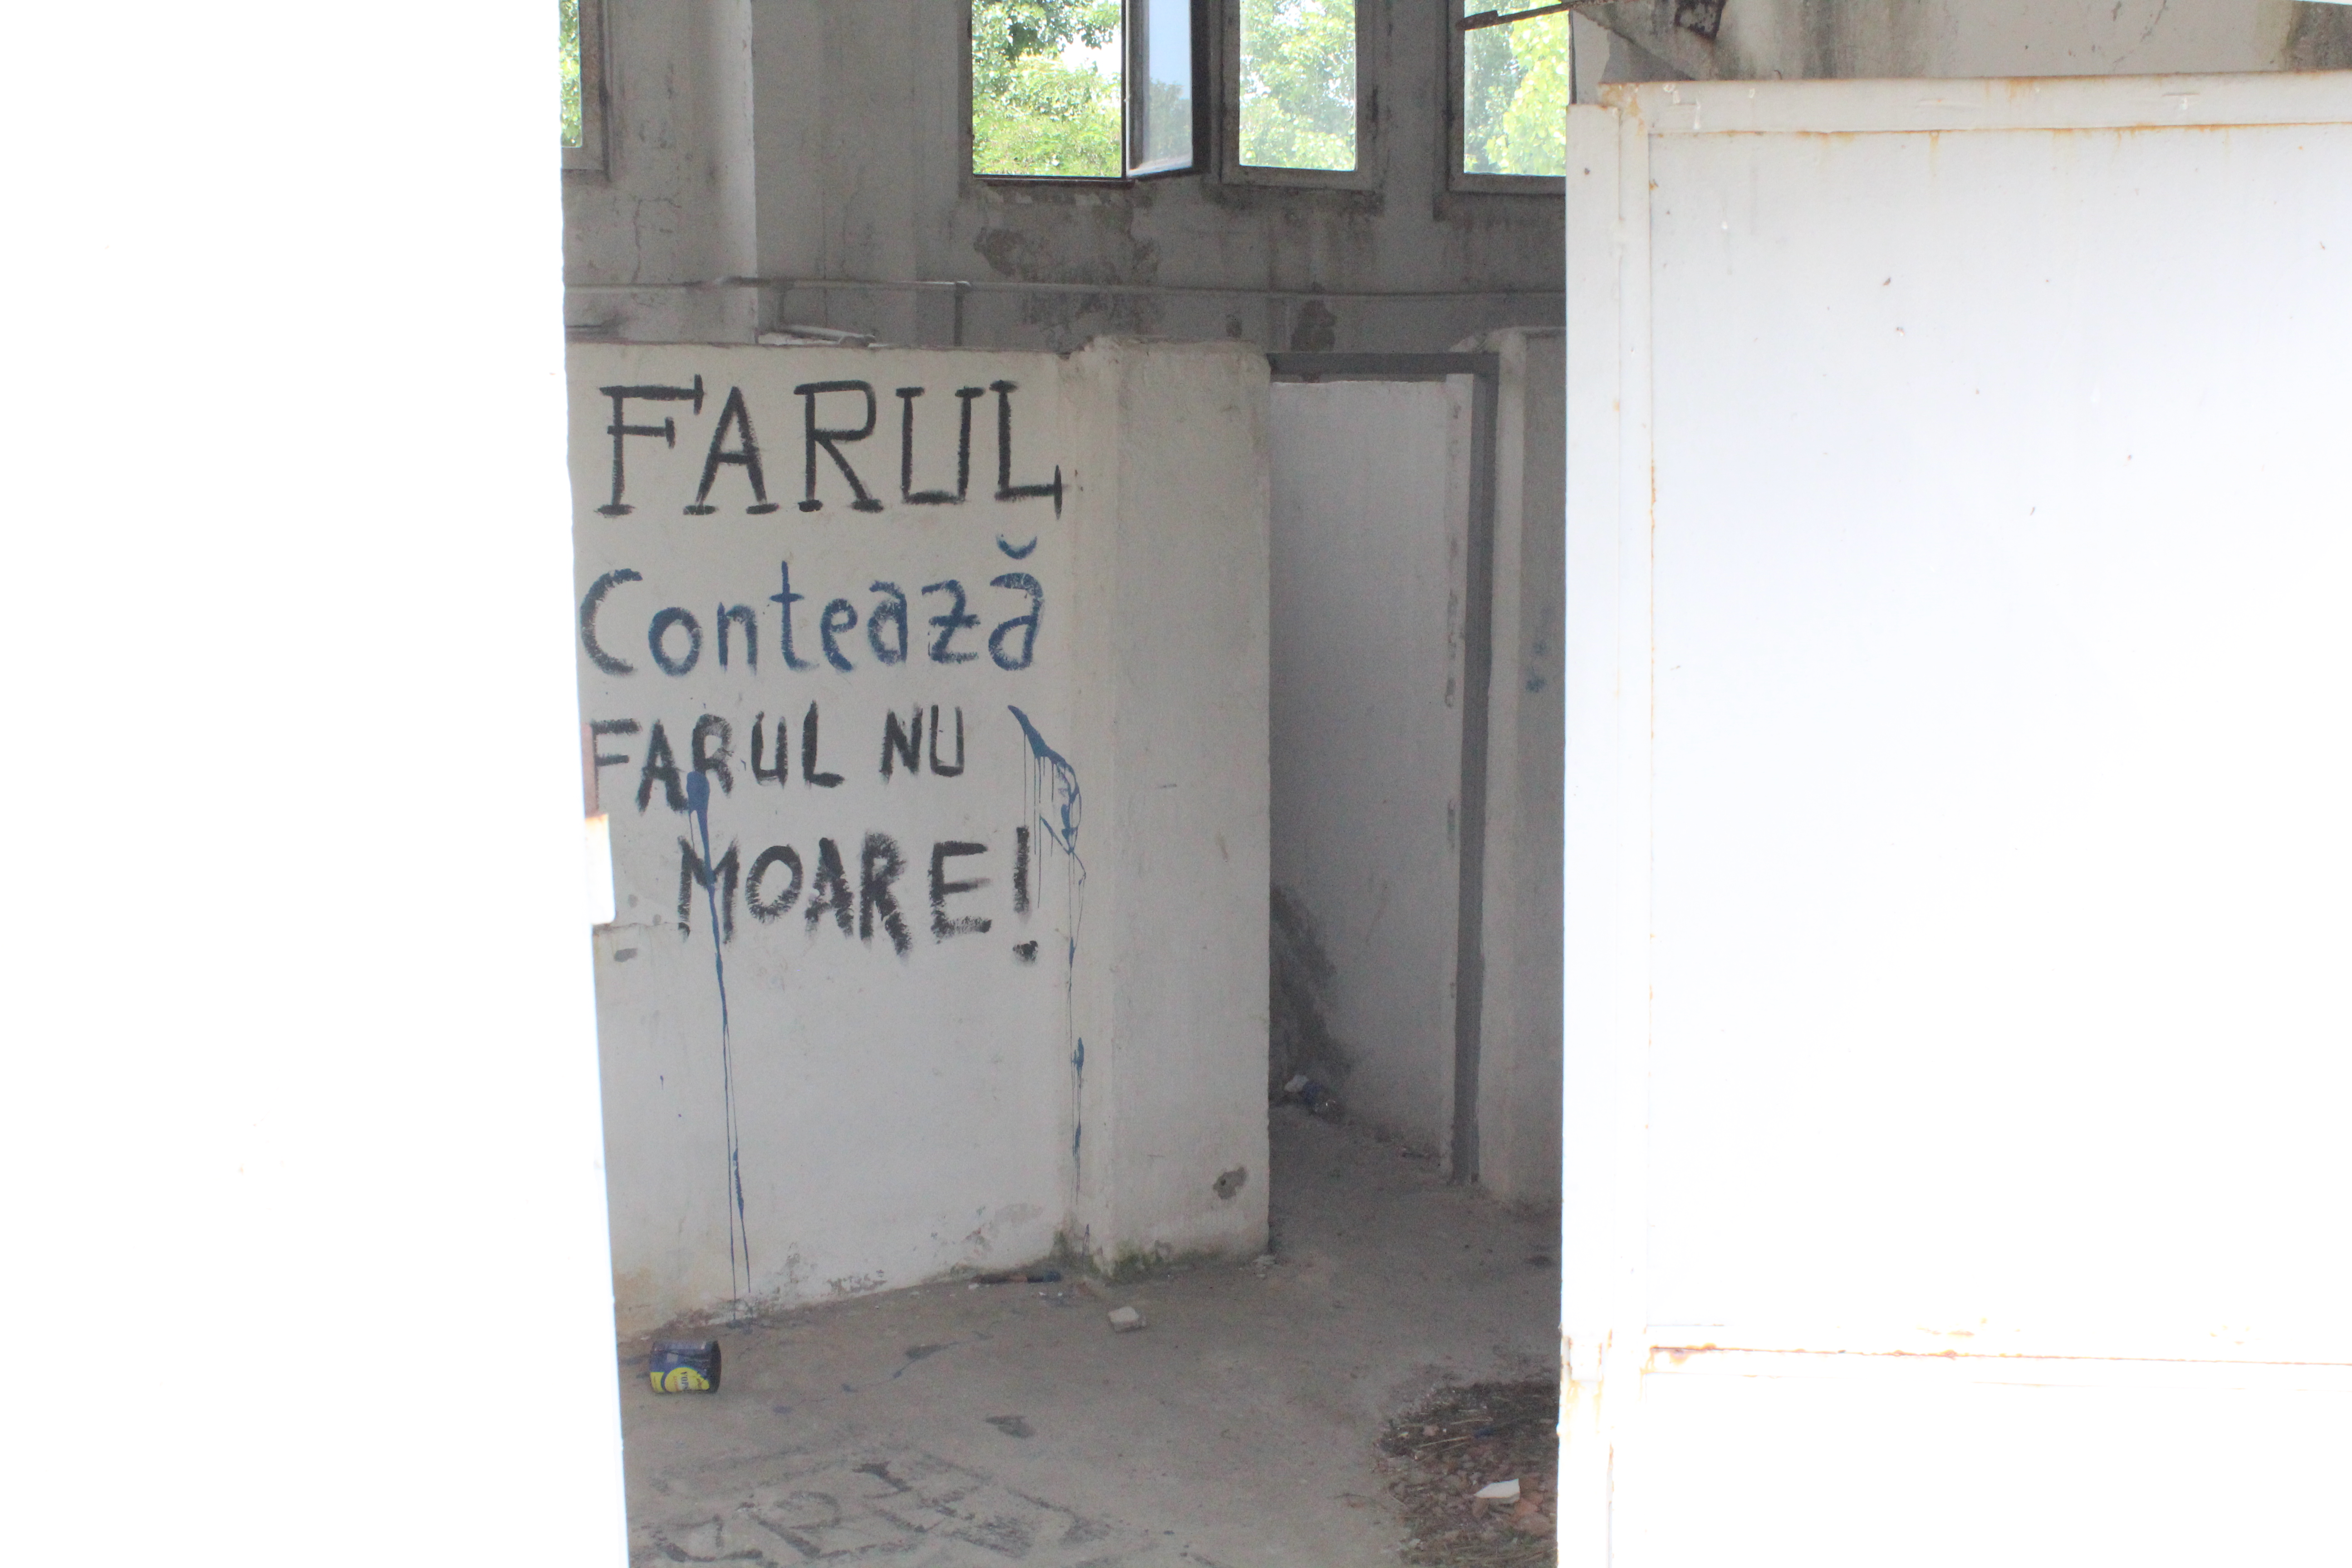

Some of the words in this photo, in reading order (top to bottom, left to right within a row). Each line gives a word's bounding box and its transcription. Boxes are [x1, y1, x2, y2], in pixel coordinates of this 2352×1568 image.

[597, 373, 1064, 519] FARUL
[579, 534, 1044, 676] Contează
[589, 701, 844, 813] FARUL
[879, 704, 965, 784] NU
[676, 826, 1039, 963] MOARE!
